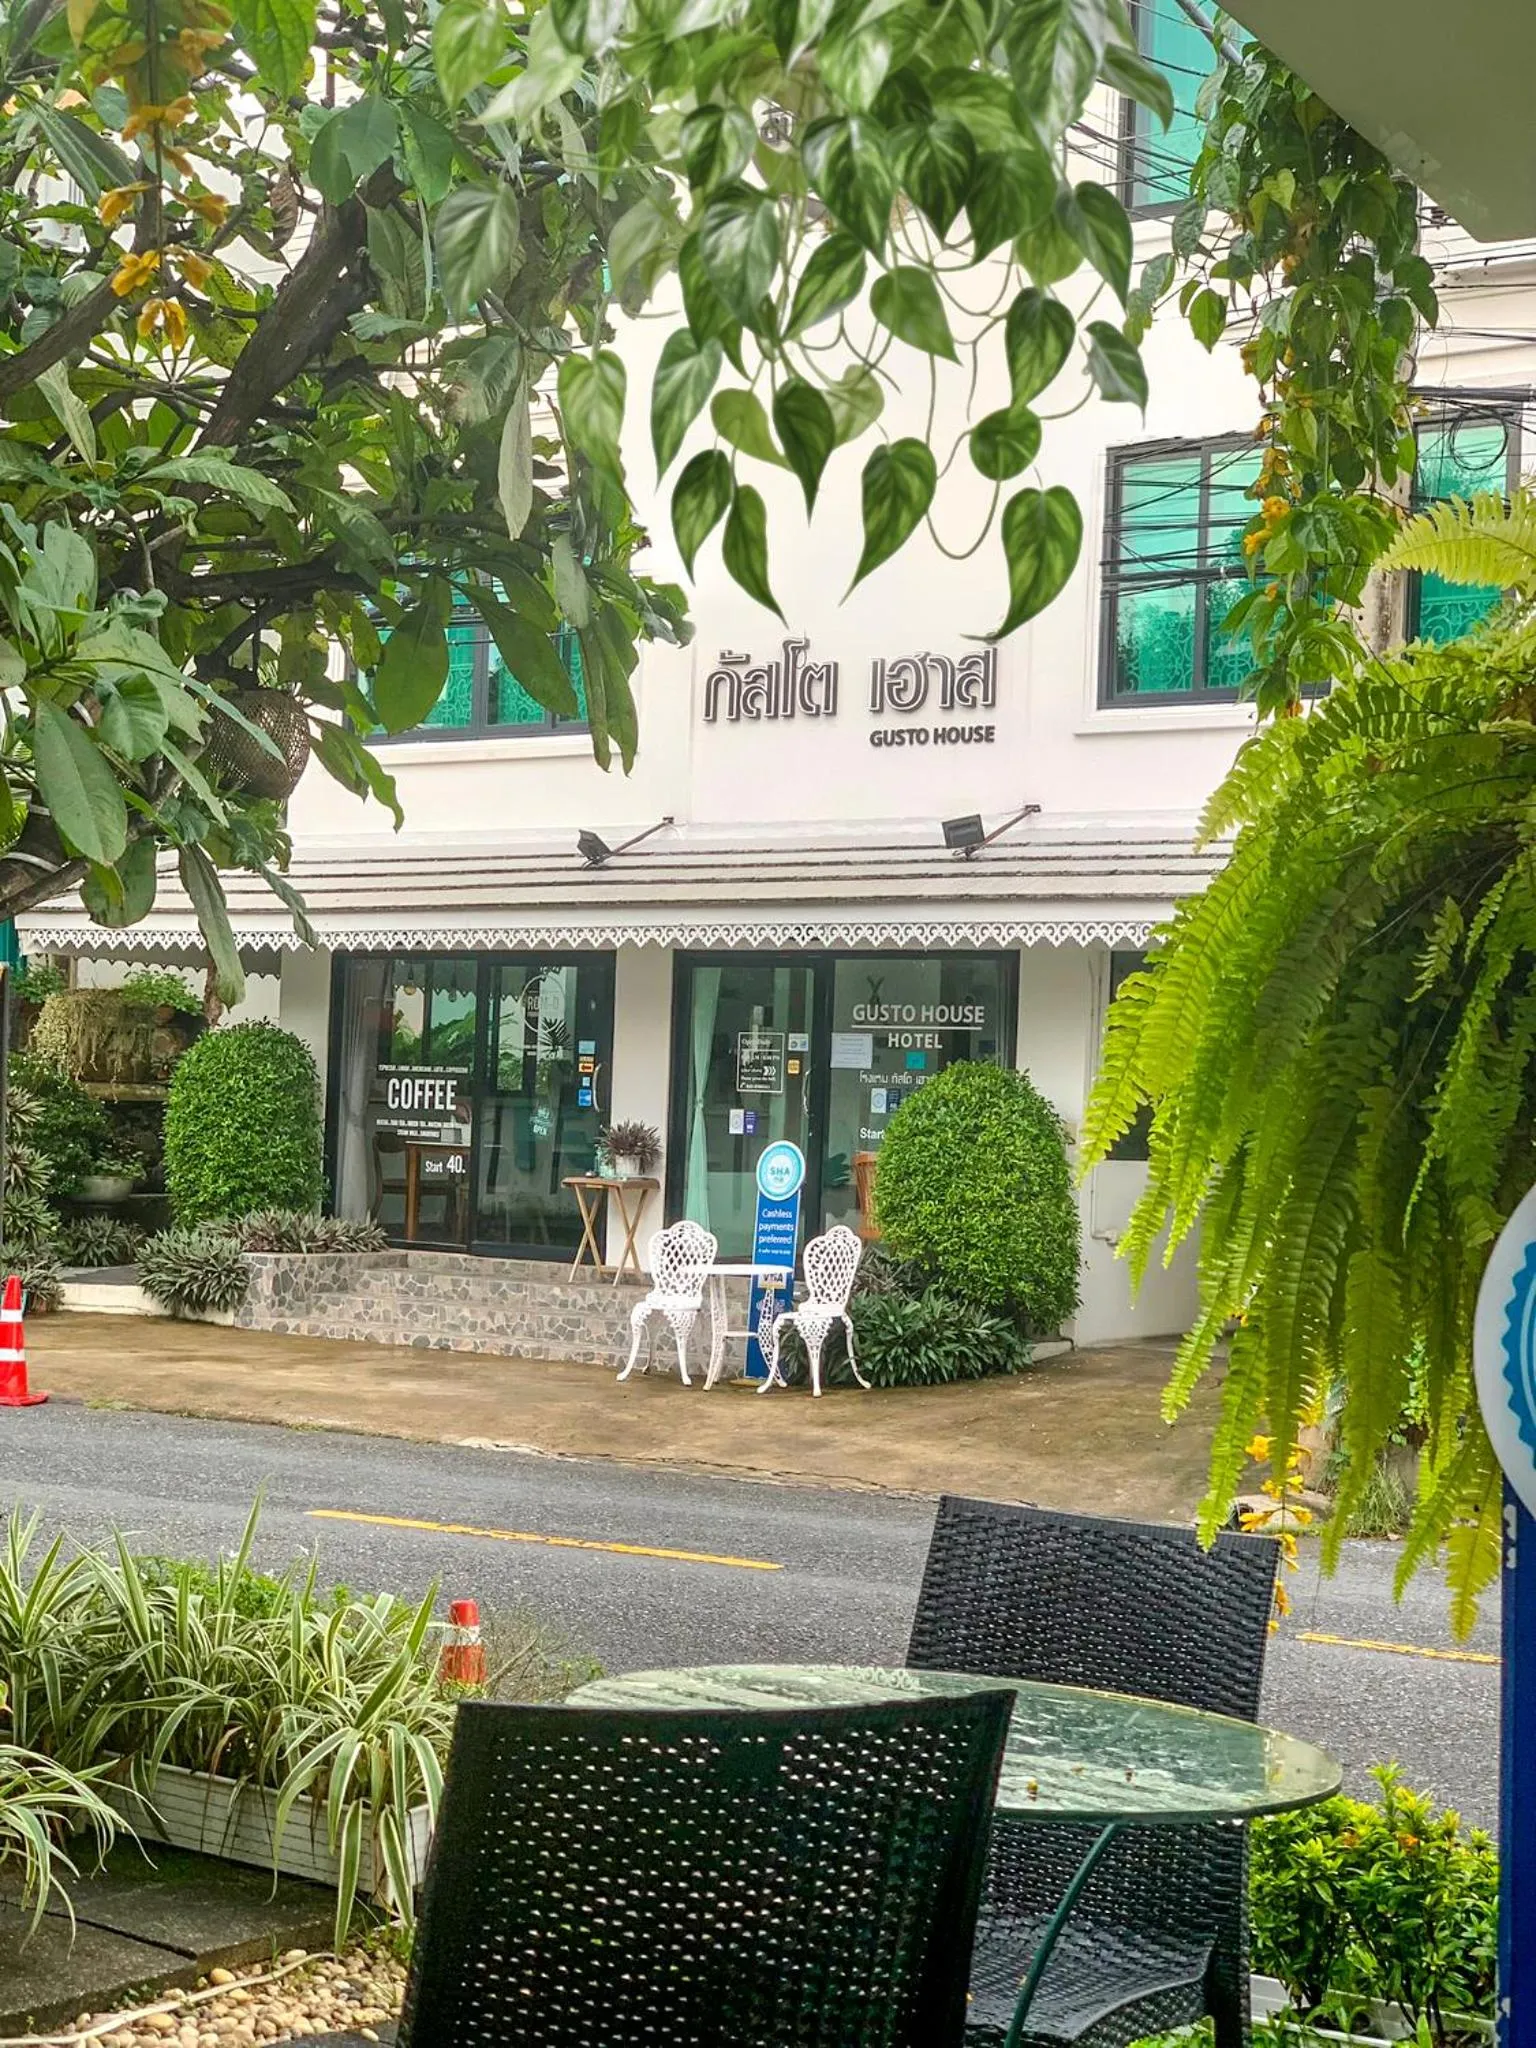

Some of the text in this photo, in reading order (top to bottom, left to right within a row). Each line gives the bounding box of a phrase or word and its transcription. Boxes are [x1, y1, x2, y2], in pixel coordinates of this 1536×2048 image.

[703, 637, 838, 722] กัสโต
[869, 725, 995, 748] GUSTO HOUSE
[852, 1003, 985, 1024] GUSTO HOUSE
[888, 1032, 943, 1049] HOTEL
[387, 1077, 458, 1112] COFFEE
[425, 1160, 443, 1173] Start
[770, 1167, 790, 1176] SHA
[762, 1209, 793, 1219] Cashless
[758, 1223, 794, 1232] payments
[758, 1234, 793, 1244] preferred
